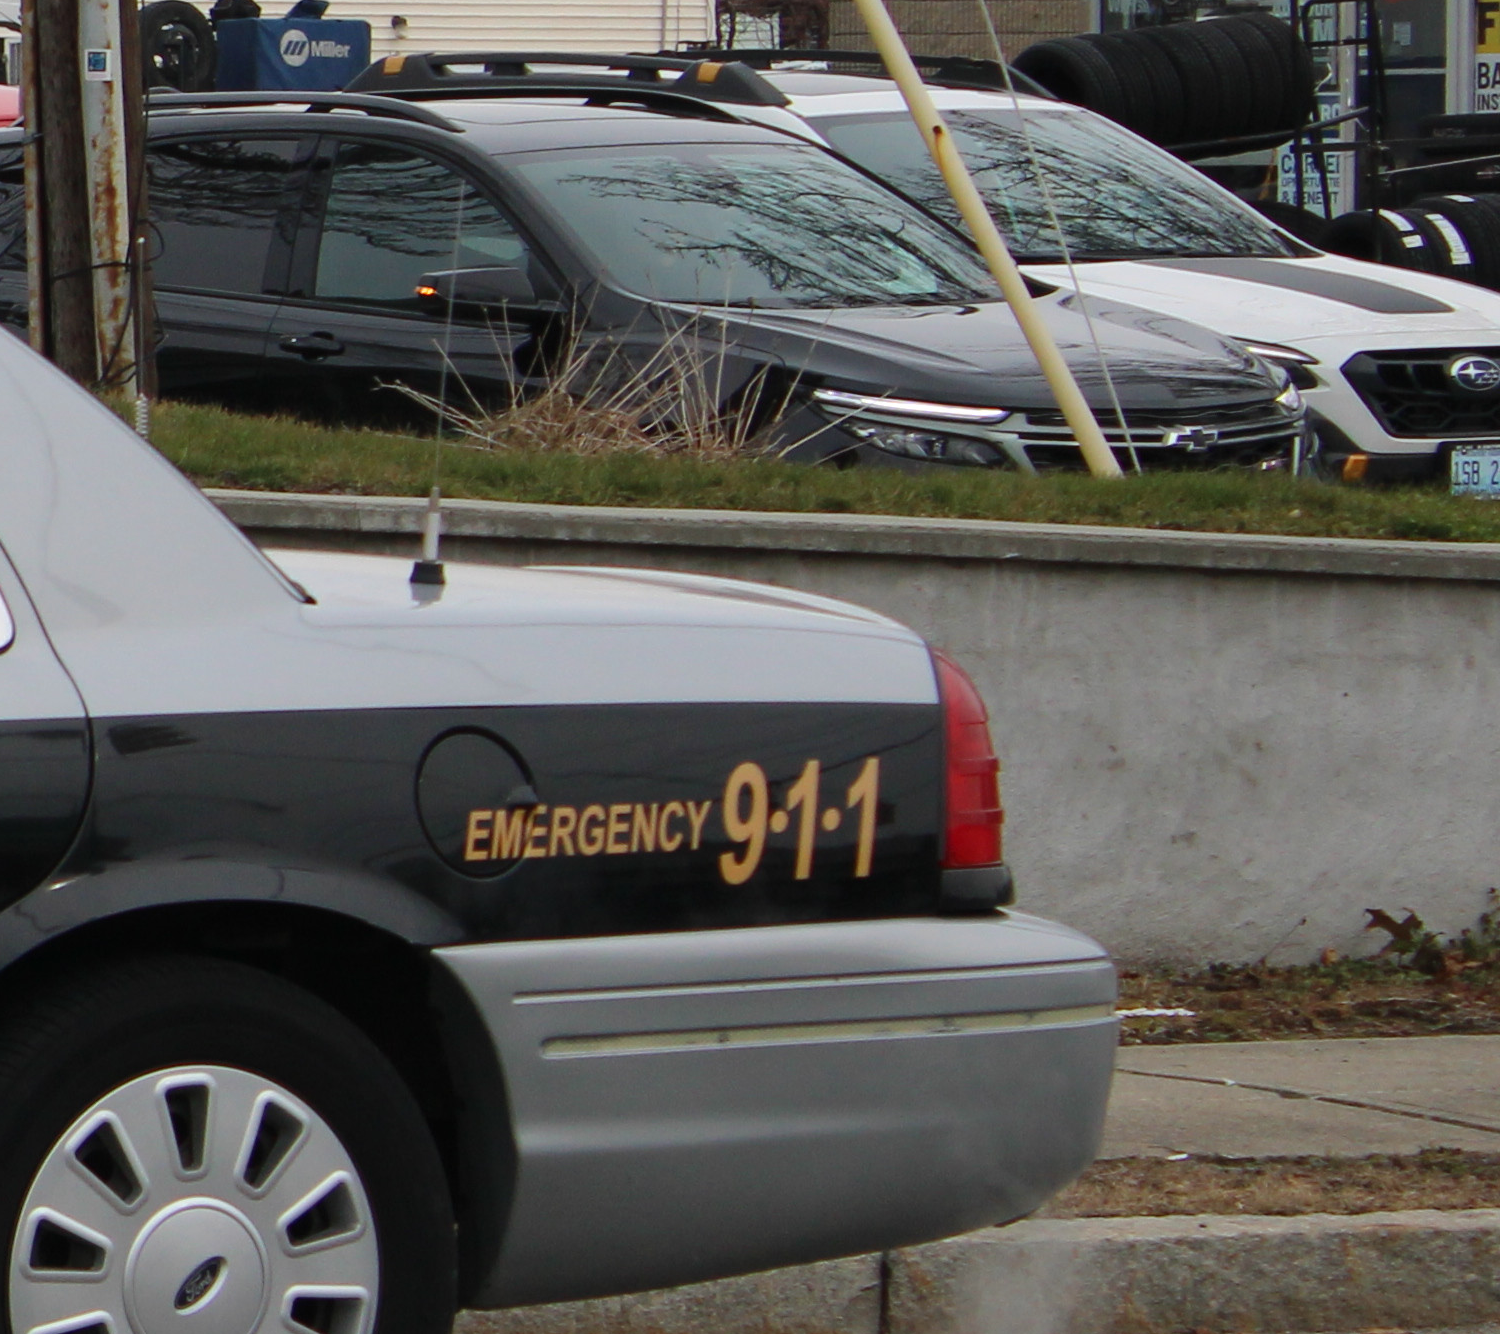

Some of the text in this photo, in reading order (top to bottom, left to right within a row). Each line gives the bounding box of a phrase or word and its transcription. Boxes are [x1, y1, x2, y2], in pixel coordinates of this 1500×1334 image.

[310, 41, 350, 58] Miller
[1477, 94, 1500, 111] INS
[464, 800, 712, 862] EMERGENCY
